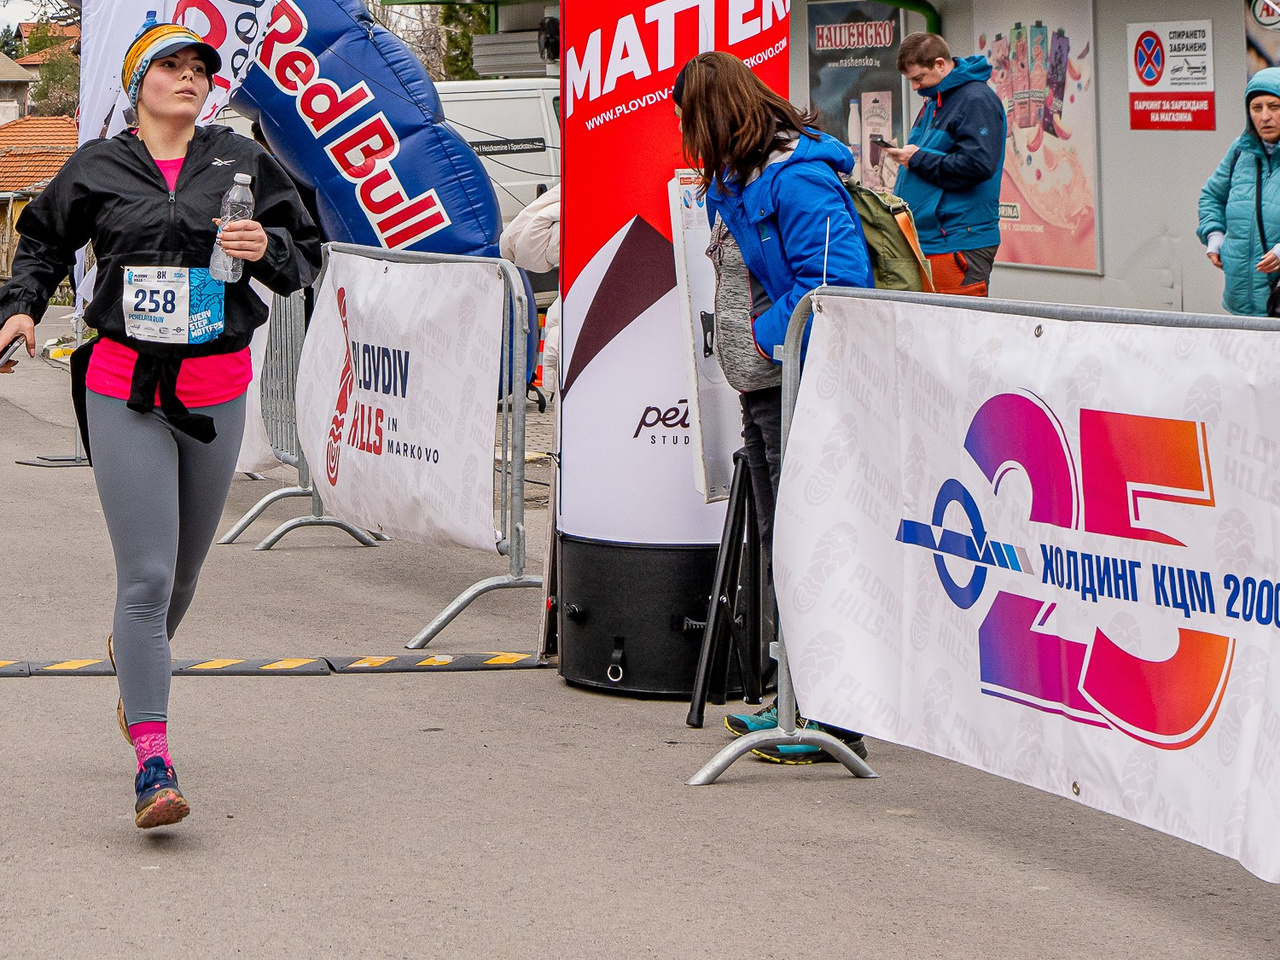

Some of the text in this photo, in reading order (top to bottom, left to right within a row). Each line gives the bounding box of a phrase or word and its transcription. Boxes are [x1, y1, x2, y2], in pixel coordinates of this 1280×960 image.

[815, 21, 893, 50] НАШЕНСКО
[1169, 30, 1206, 40] СПИРАНЕТО
[1169, 43, 1206, 52] ЗАБРАНЕНО
[828, 56, 880, 67] www.nashensko.bg
[1134, 100, 1209, 111] ПАРКИНГ ЗА ЗАРЕЖДАНЕ
[1151, 113, 1192, 122] НА МАГАЗИНА
[328, 114, 448, 250] Bull
[157, 271, 167, 279] 8K
[133, 289, 176, 314] 258
[190, 320, 208, 330] STEP
[351, 340, 410, 399] PLOVDIV
[387, 417, 398, 432] IN
[651, 435, 690, 445] STUD
[387, 439, 440, 464] MARKOVO
[1040, 543, 1141, 603] ХОЛДИНГ
[1151, 563, 1216, 618] КЦМ
